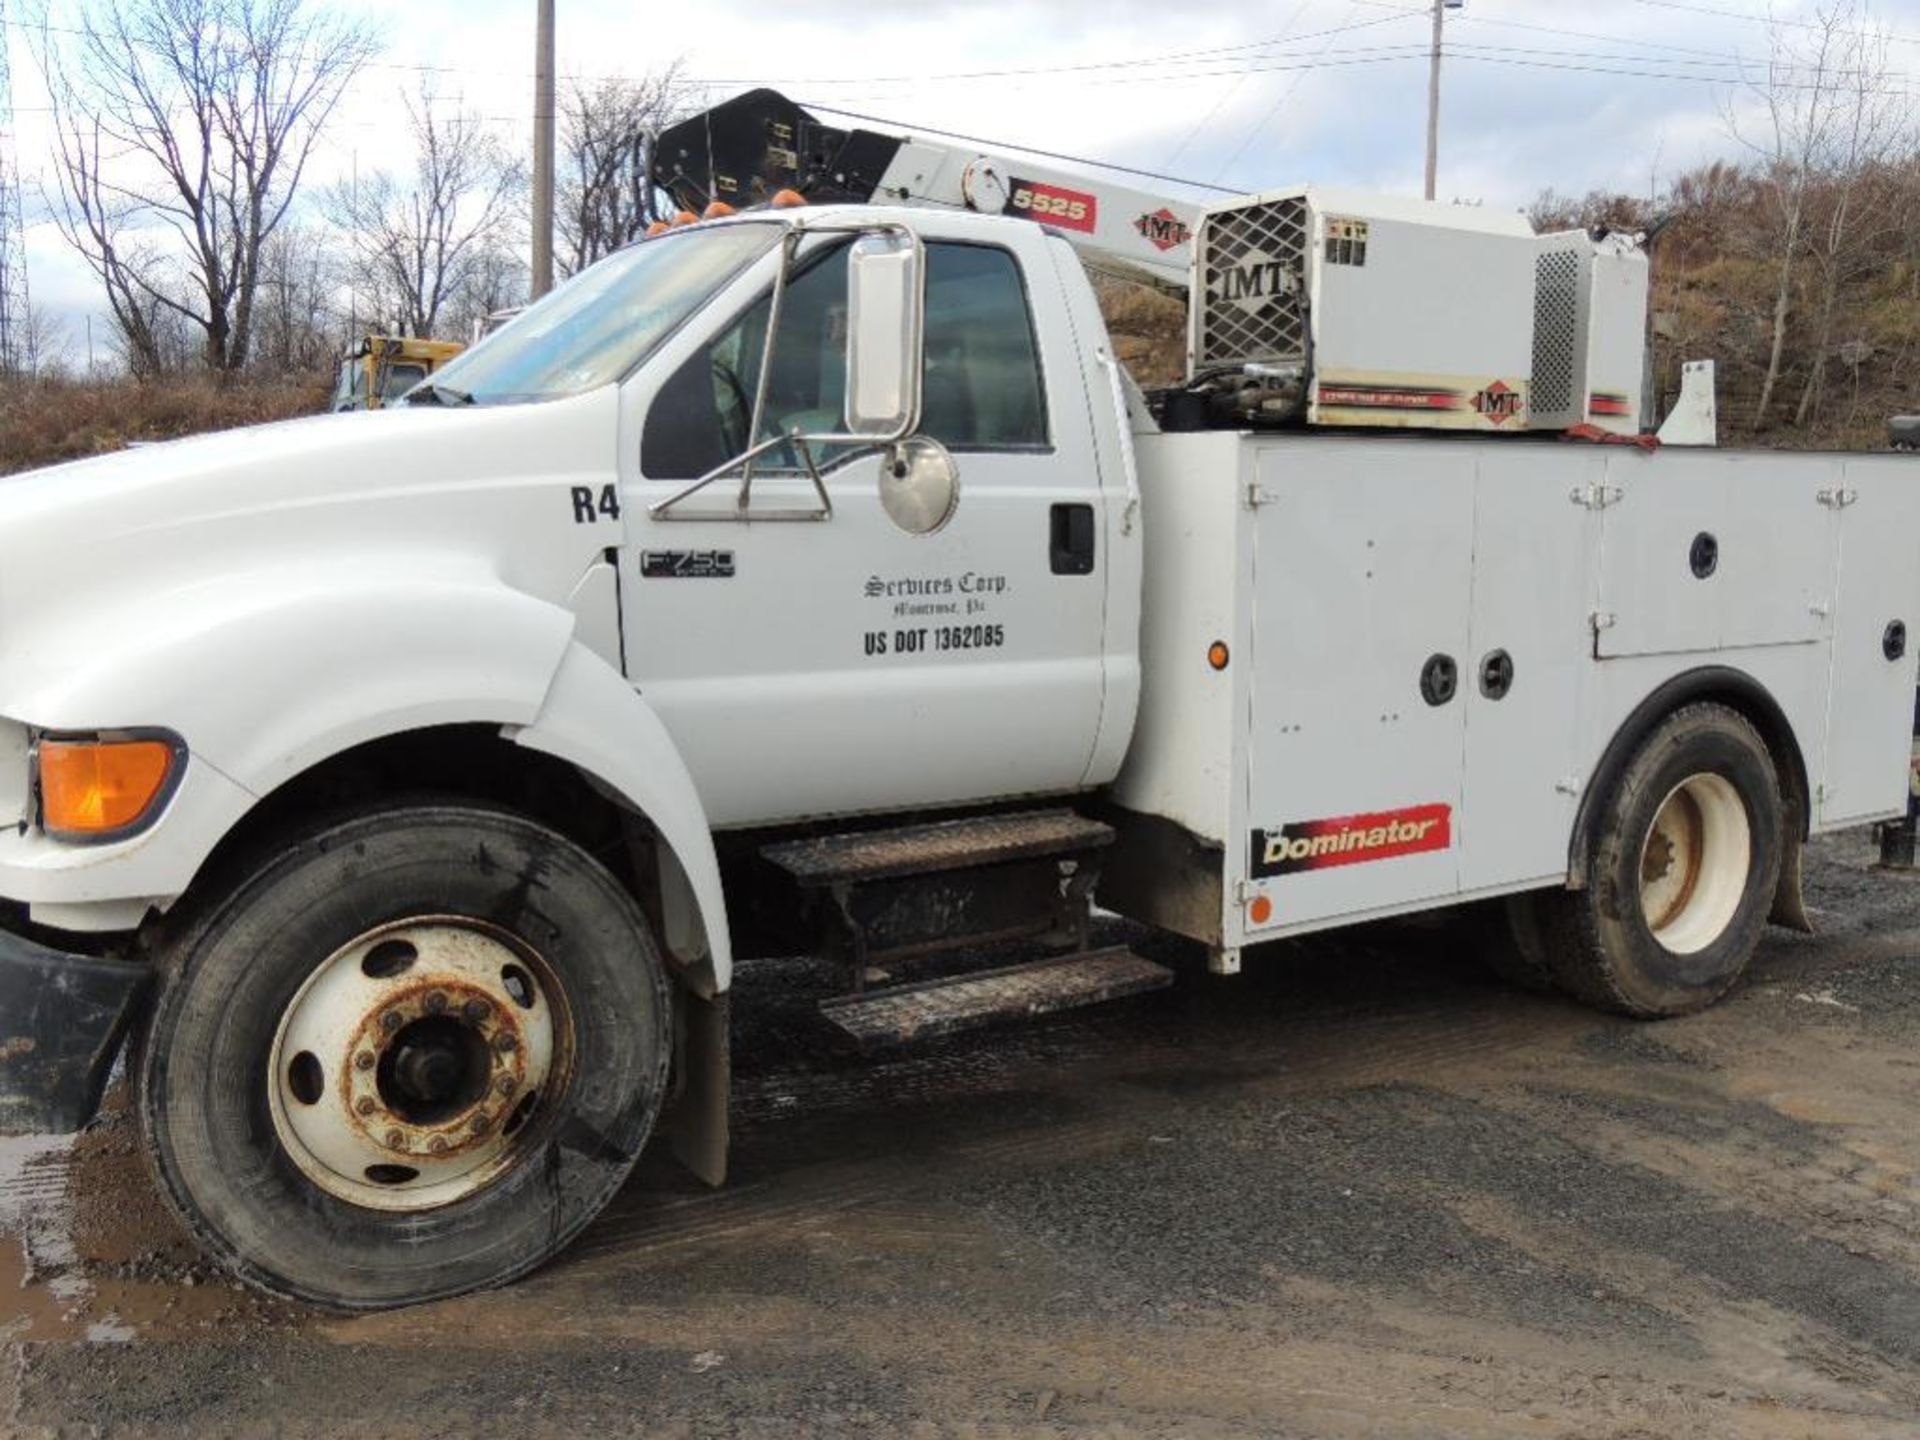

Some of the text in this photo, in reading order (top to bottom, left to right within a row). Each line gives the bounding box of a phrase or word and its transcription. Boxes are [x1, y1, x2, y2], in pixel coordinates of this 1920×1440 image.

[1012, 188, 1088, 221] 5525
[1140, 213, 1187, 245] IMT
[1220, 259, 1289, 300] IMT
[1476, 391, 1520, 414] IMT
[571, 483, 620, 523] R4
[864, 571, 1011, 597] Services Corp.
[864, 624, 1004, 655] US DOT 1362085
[1263, 818, 1434, 864] Dominator
